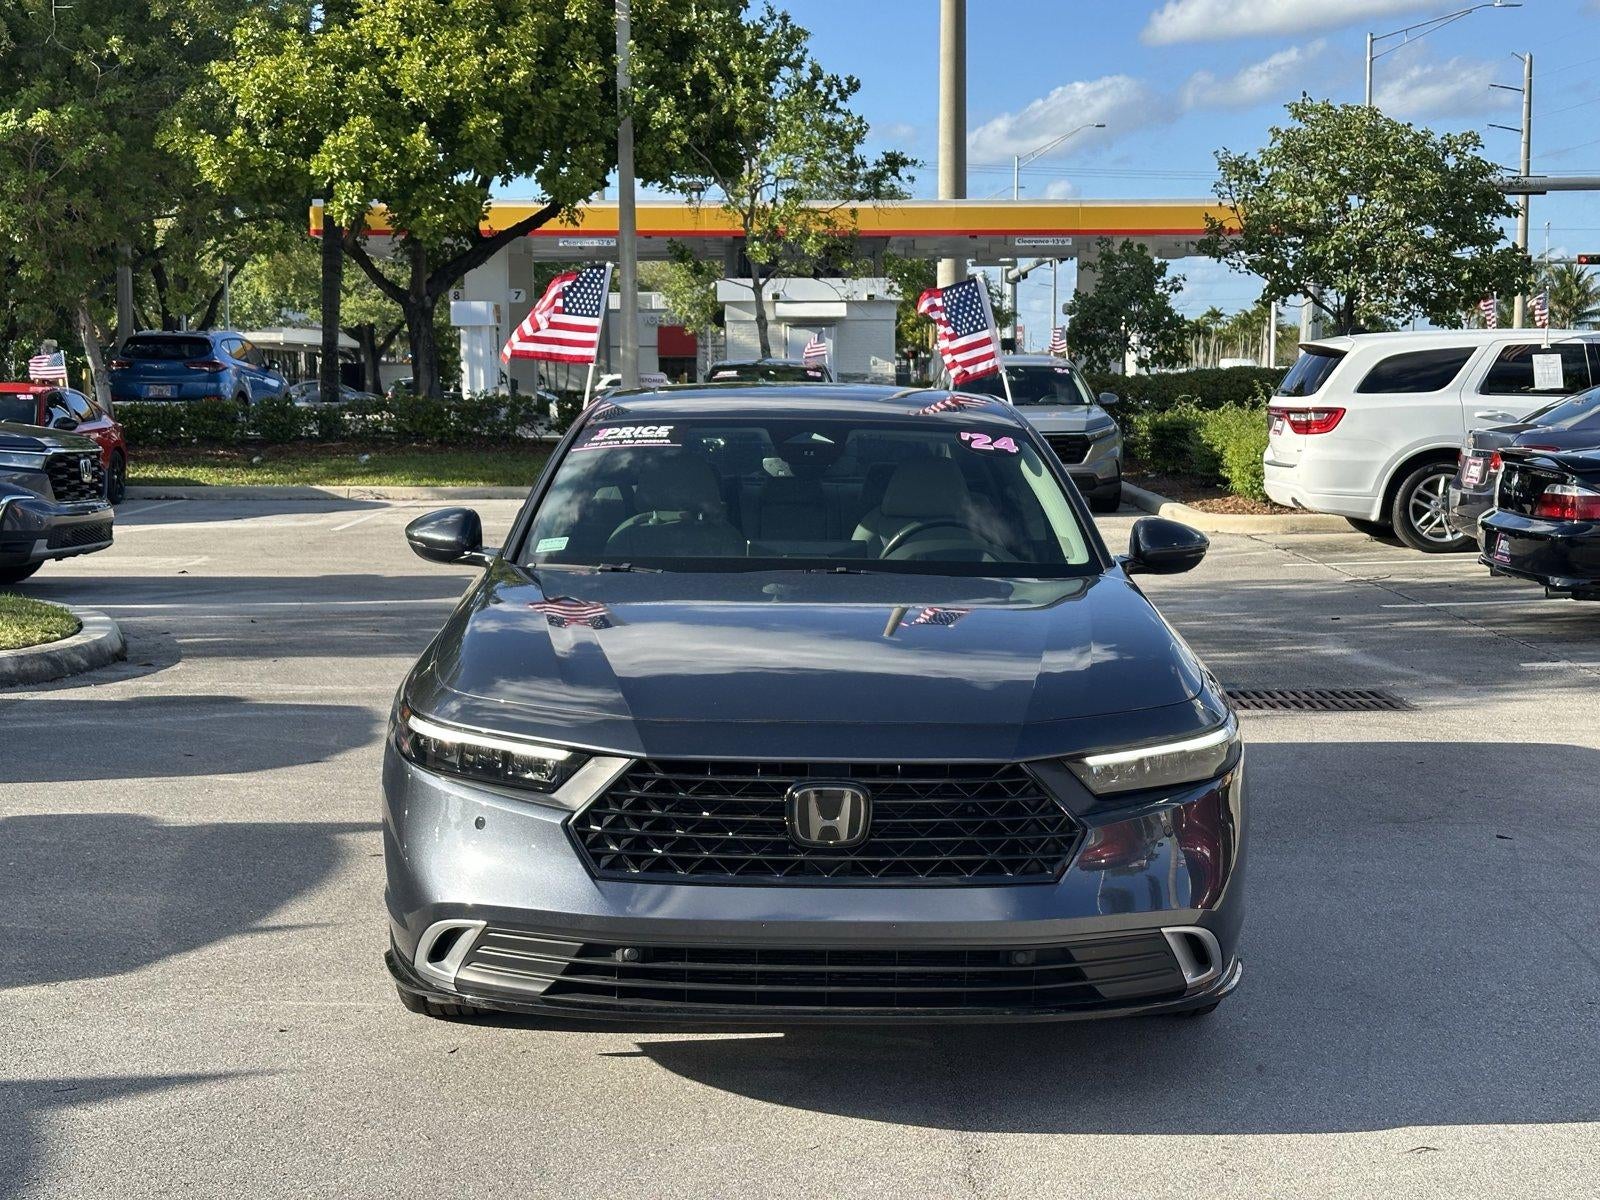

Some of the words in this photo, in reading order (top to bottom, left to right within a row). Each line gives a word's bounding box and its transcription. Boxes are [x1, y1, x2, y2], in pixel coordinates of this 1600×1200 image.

[453, 291, 460, 300] 8
[514, 291, 522, 300] 7
[960, 431, 1020, 453] '24
